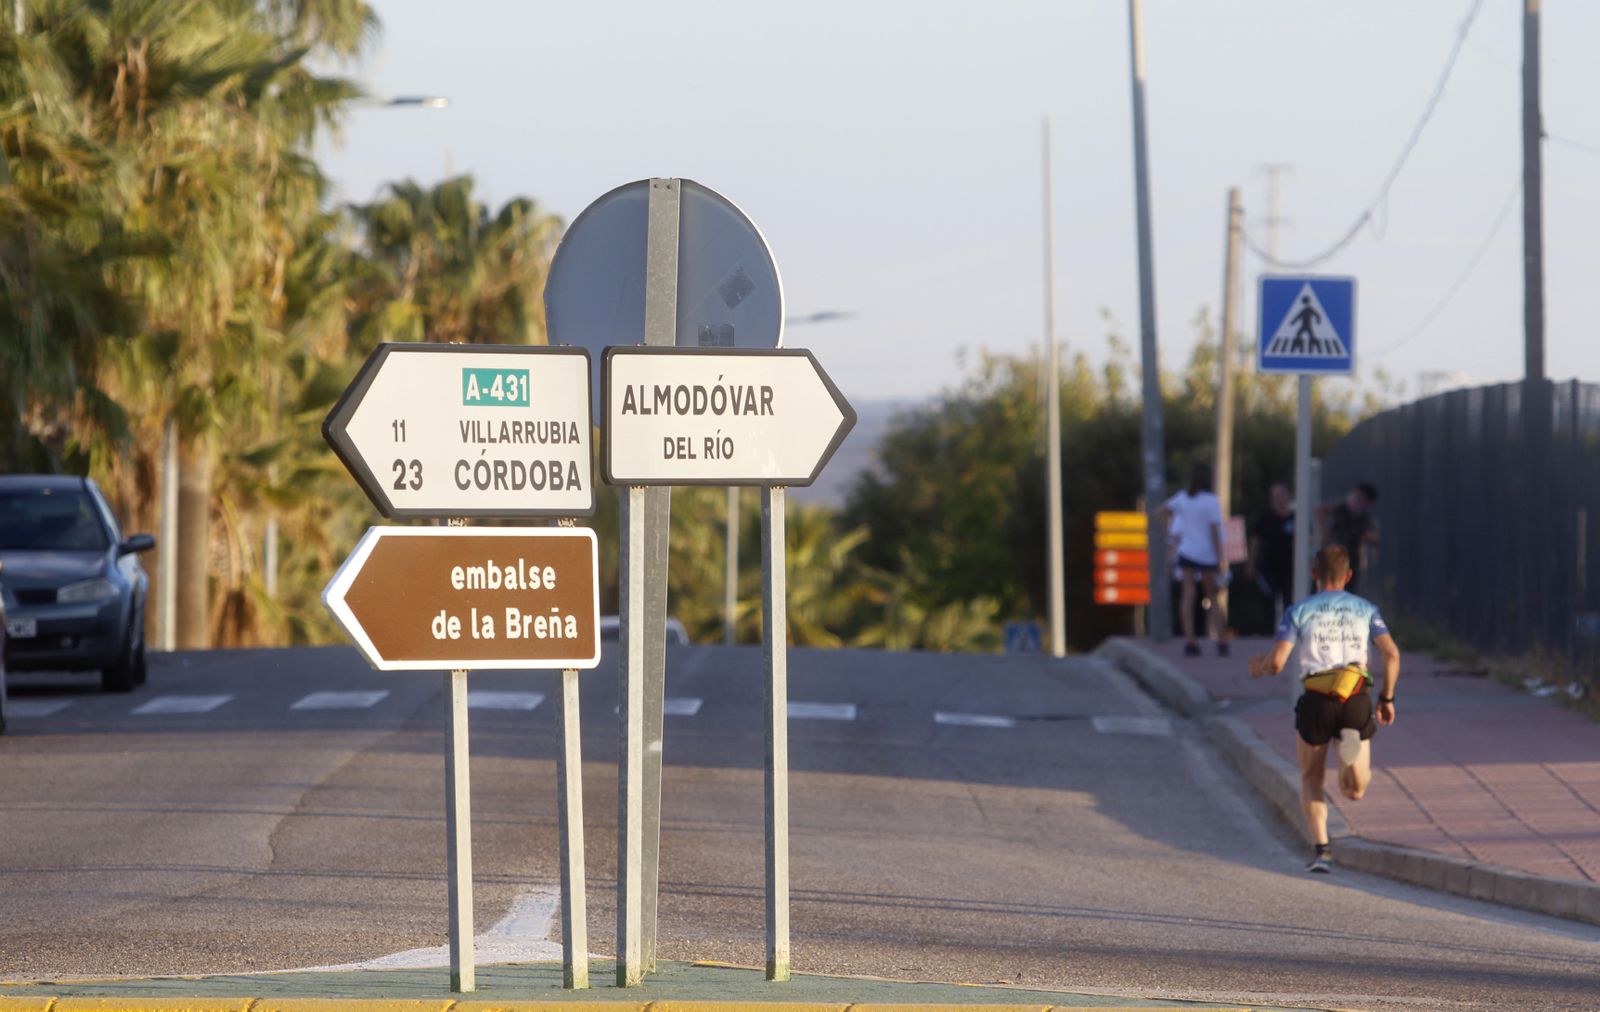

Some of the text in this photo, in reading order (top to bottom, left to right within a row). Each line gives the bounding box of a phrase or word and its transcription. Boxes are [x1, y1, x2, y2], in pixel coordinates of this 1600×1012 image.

[466, 374, 528, 401] A-431
[622, 375, 774, 415] ALMODÓVAR
[393, 420, 580, 444] 11 VILLARRUBIA
[664, 430, 734, 459] DEL RÍO
[393, 449, 581, 490] 23 CÓRDOBA
[451, 559, 555, 589] embalse
[432, 608, 577, 639] de la Breña
